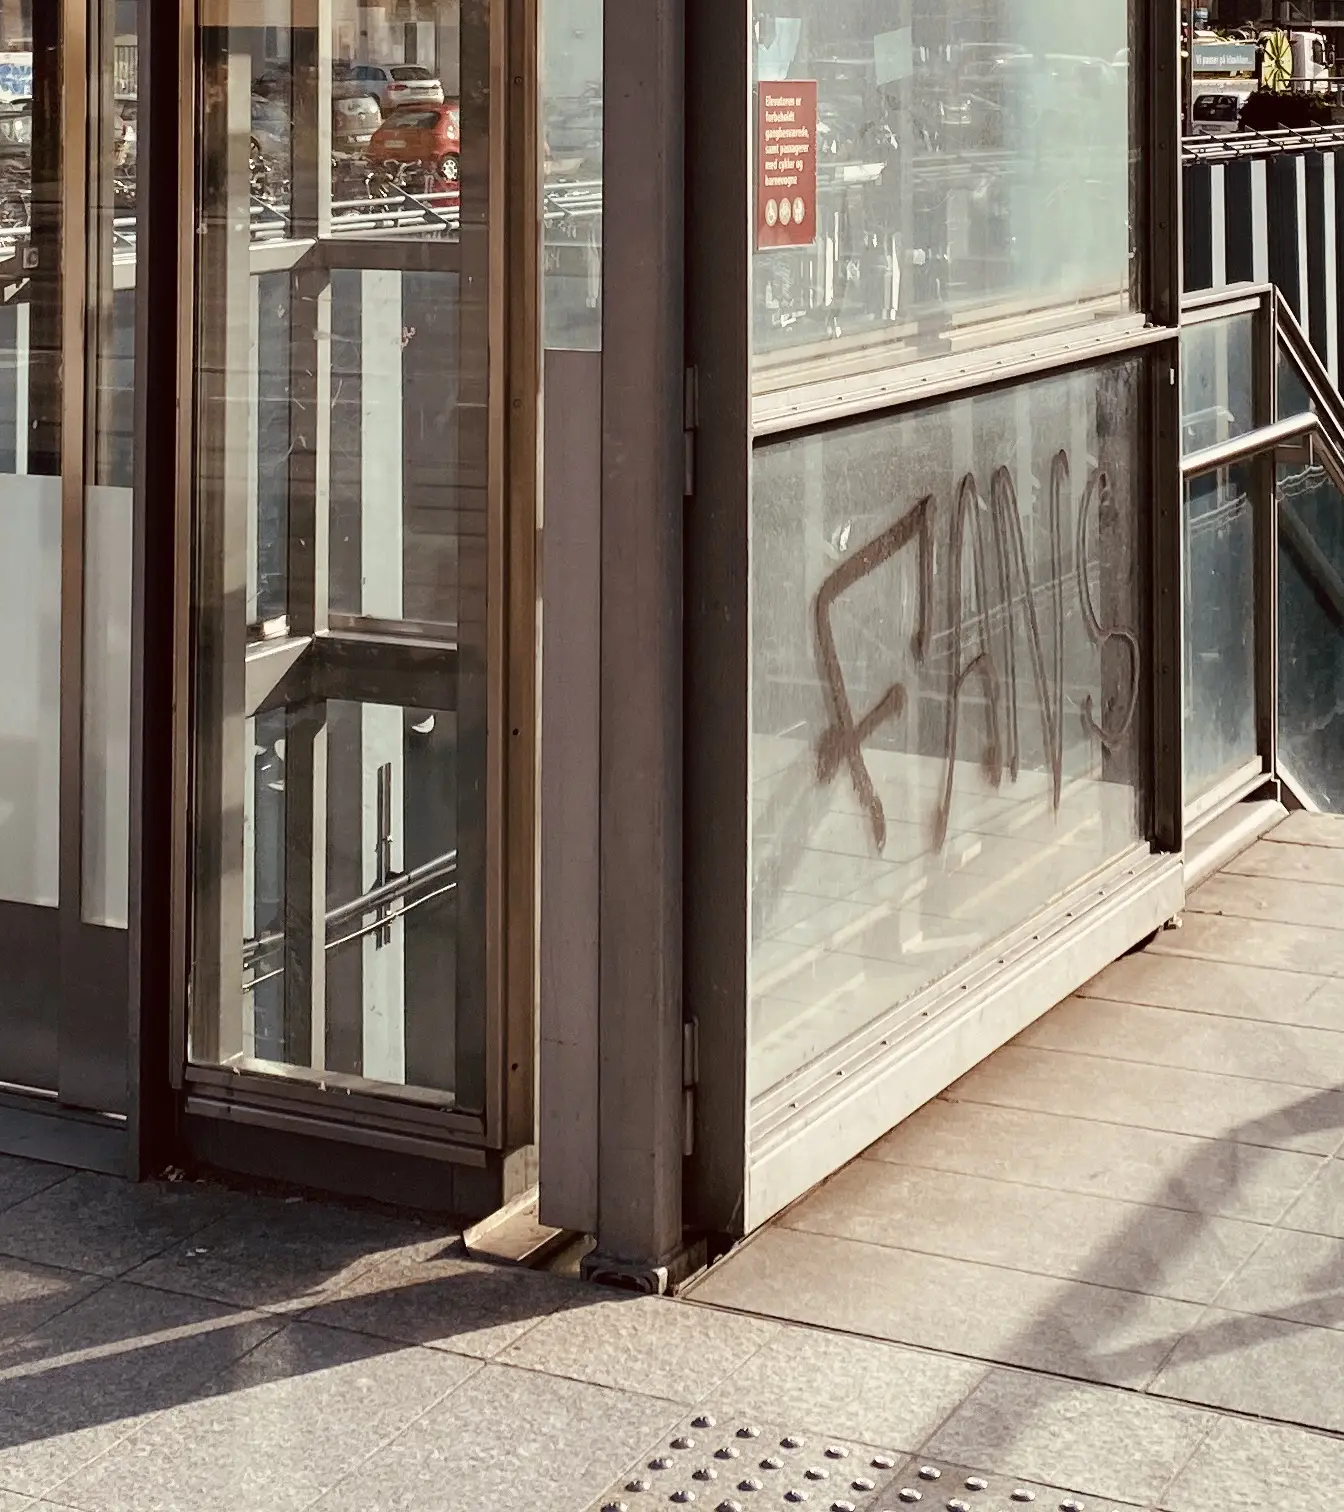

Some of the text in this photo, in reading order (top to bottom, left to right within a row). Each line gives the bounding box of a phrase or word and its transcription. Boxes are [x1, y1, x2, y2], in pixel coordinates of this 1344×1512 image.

[765, 95, 802, 107] Elevatoren er
[765, 110, 795, 123] forbeholdt
[765, 143, 779, 155] samt
[764, 158, 778, 170] med
[795, 159, 804, 172] og
[764, 174, 798, 188] barnevogne
